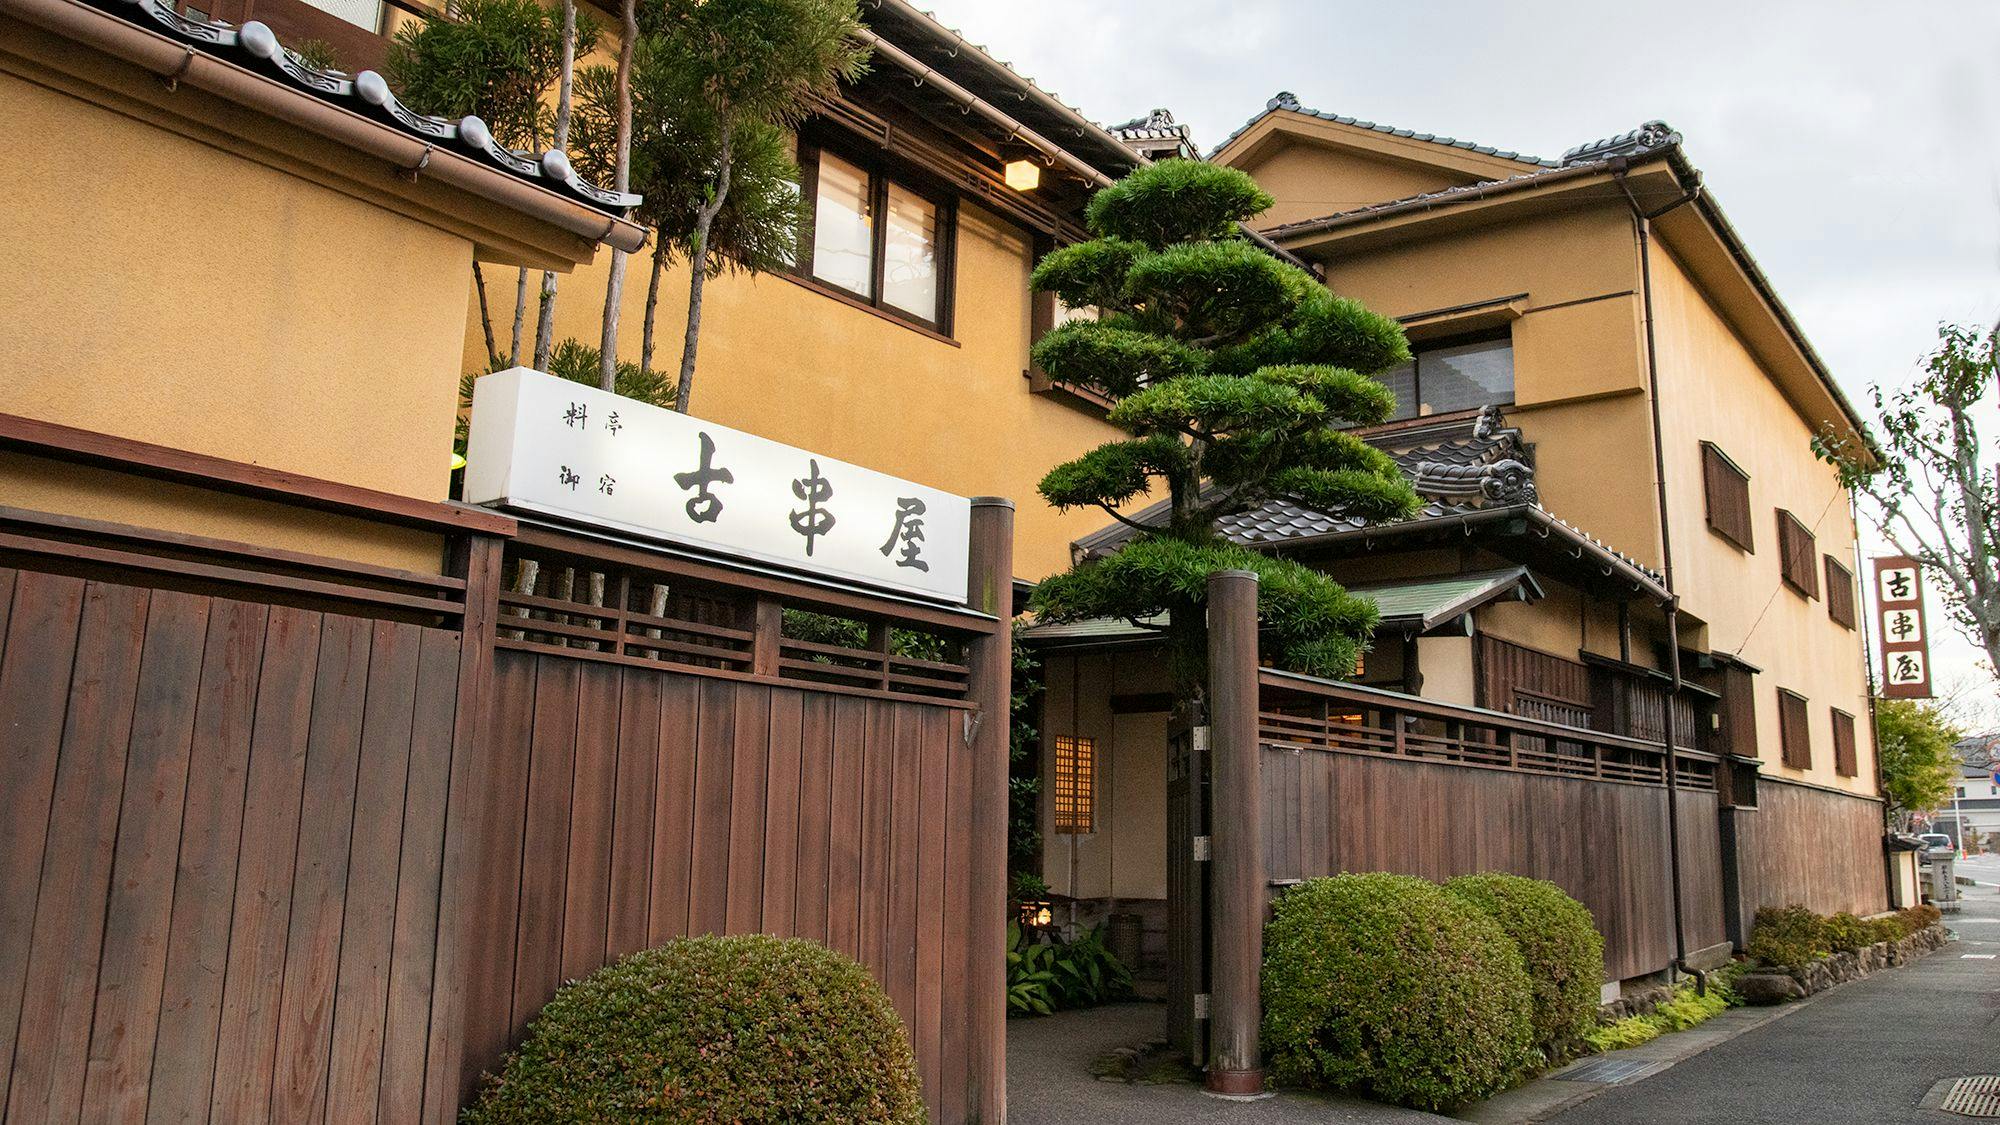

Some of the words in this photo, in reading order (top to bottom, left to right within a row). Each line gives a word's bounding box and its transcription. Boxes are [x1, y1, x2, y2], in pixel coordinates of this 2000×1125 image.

[563, 401, 623, 437] 料亭
[560, 465, 616, 495] 御宿
[673, 431, 930, 573] 古串屋
[1886, 571, 1920, 681] 古串屋
